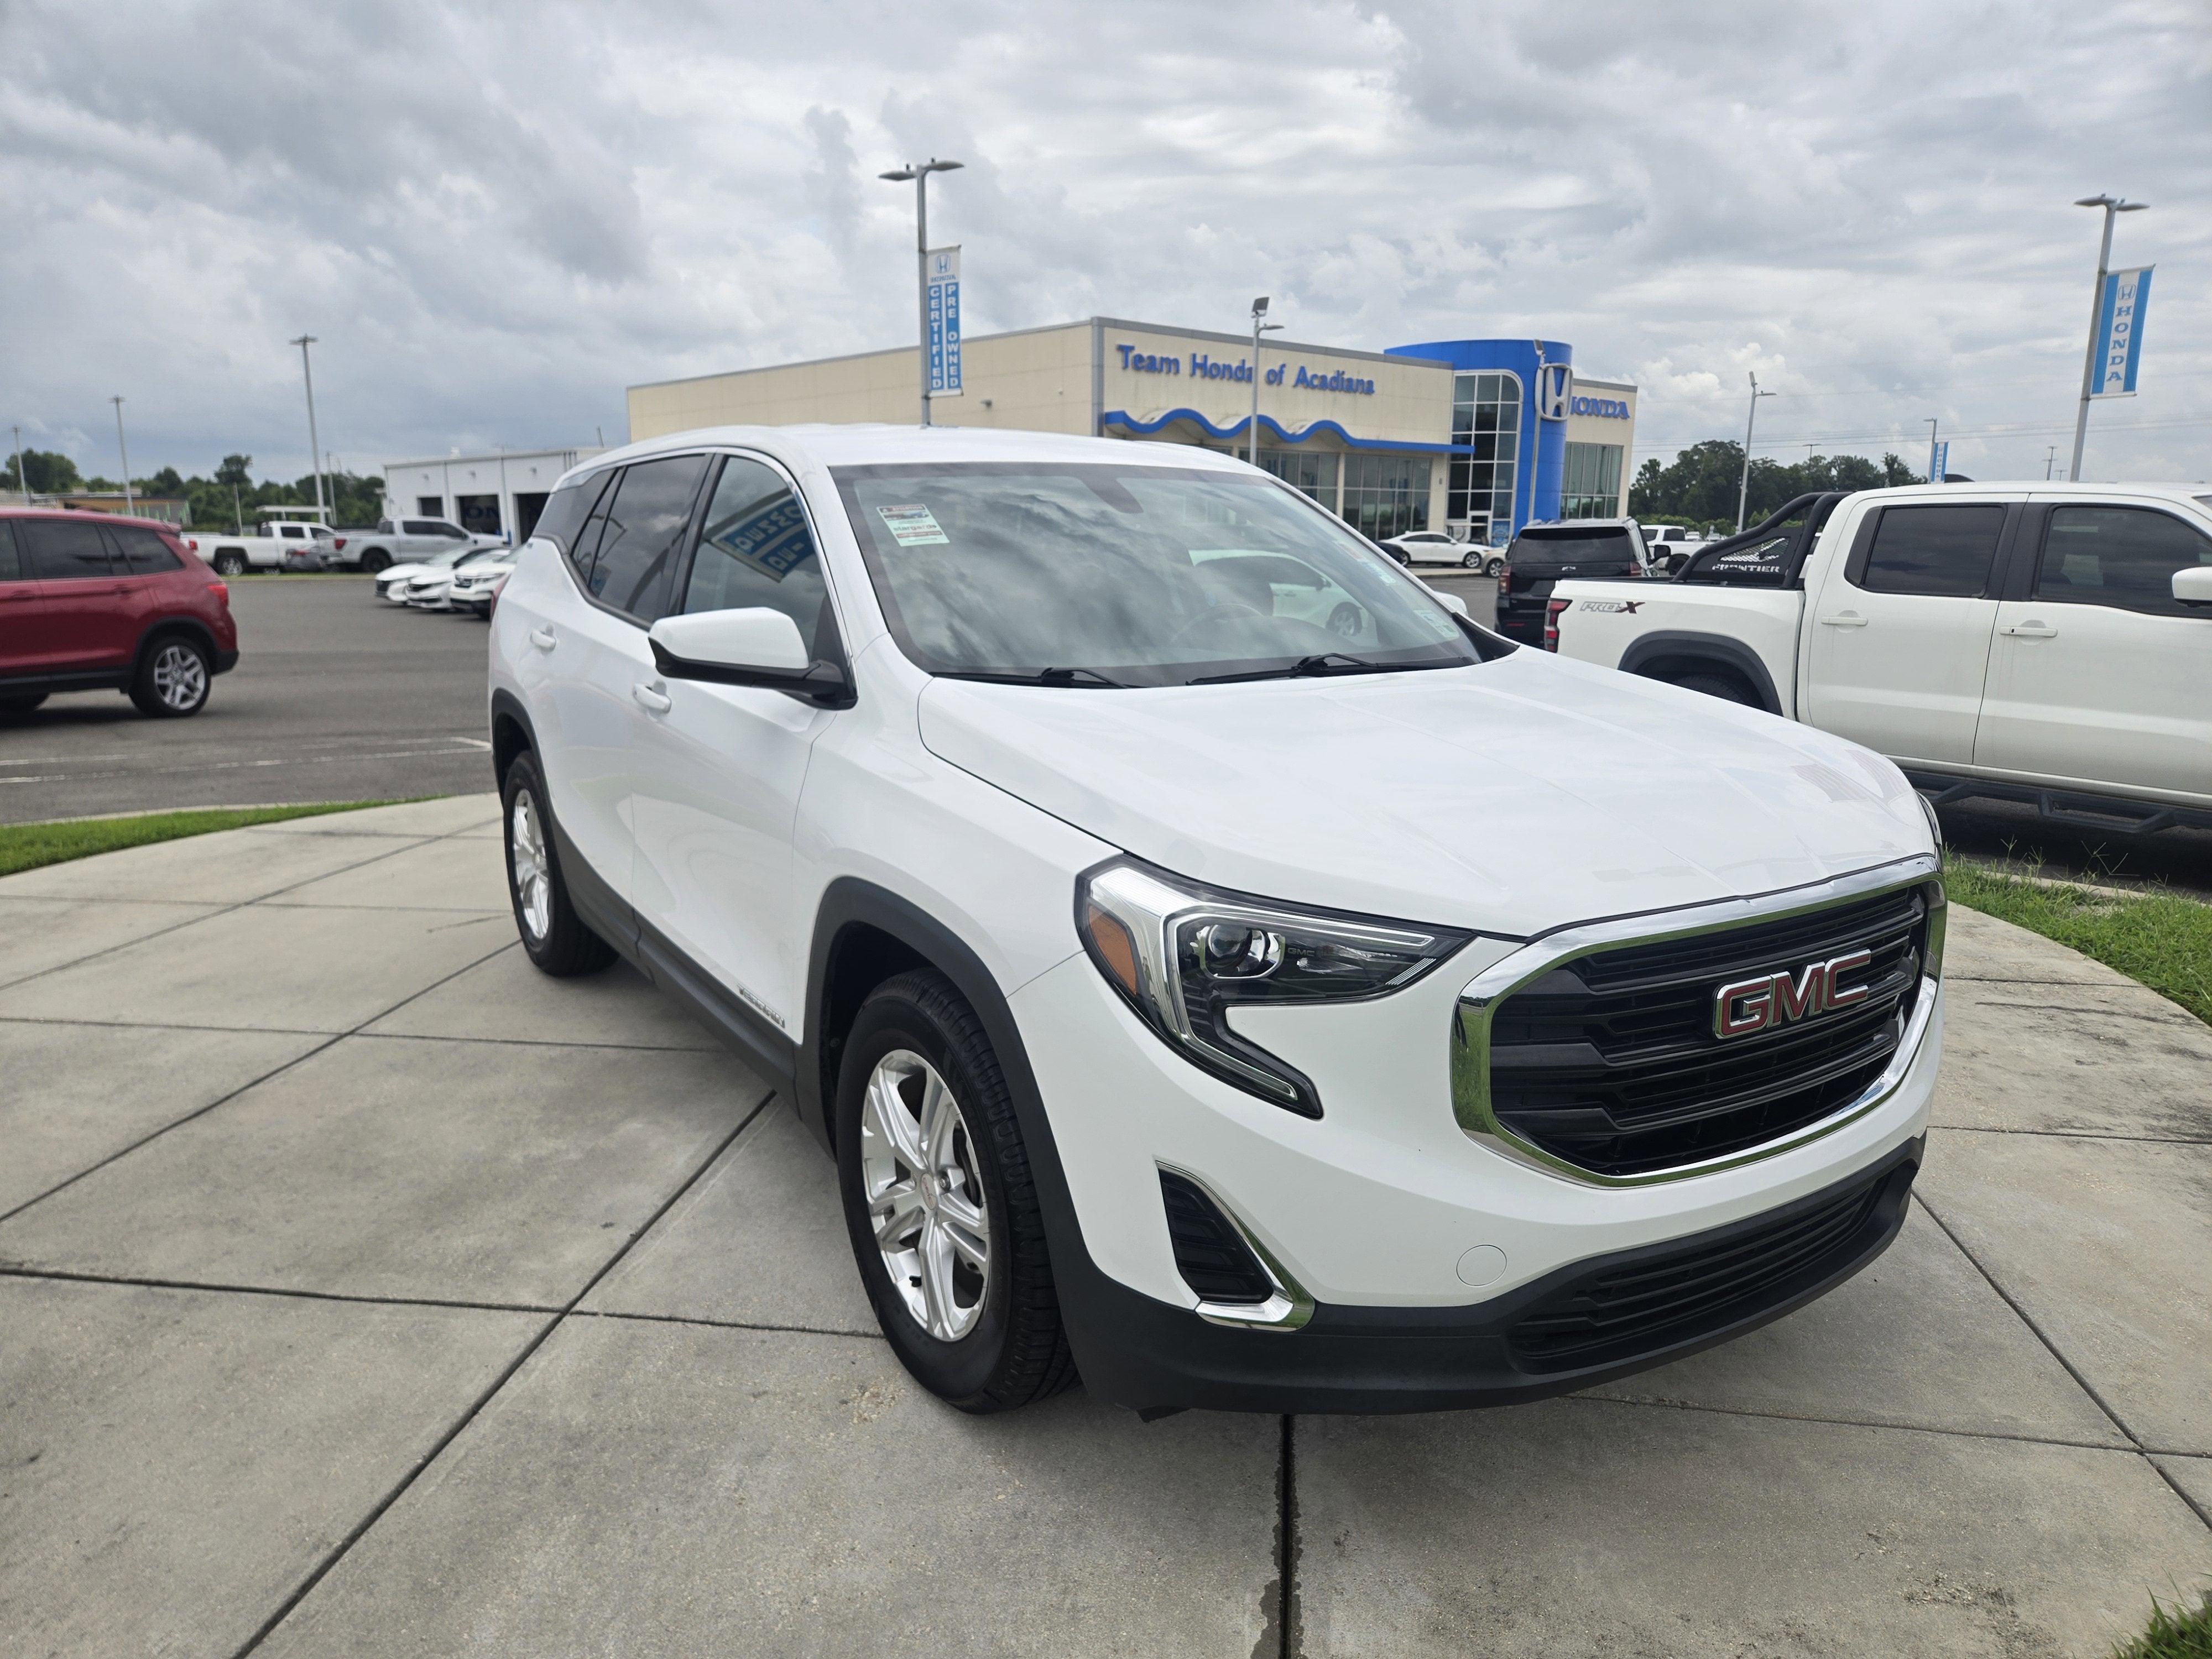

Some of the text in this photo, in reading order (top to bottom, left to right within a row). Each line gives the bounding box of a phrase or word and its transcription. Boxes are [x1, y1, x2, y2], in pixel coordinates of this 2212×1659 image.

[930, 287, 942, 388] CERTIFIED
[947, 285, 958, 387] PRE OWNED
[1117, 344, 1375, 395] Team Honda of Acadiana
[2107, 306, 2131, 381] HONDA
[1287, 947, 1314, 957] GMC
[1715, 949, 1871, 1040] GMC
